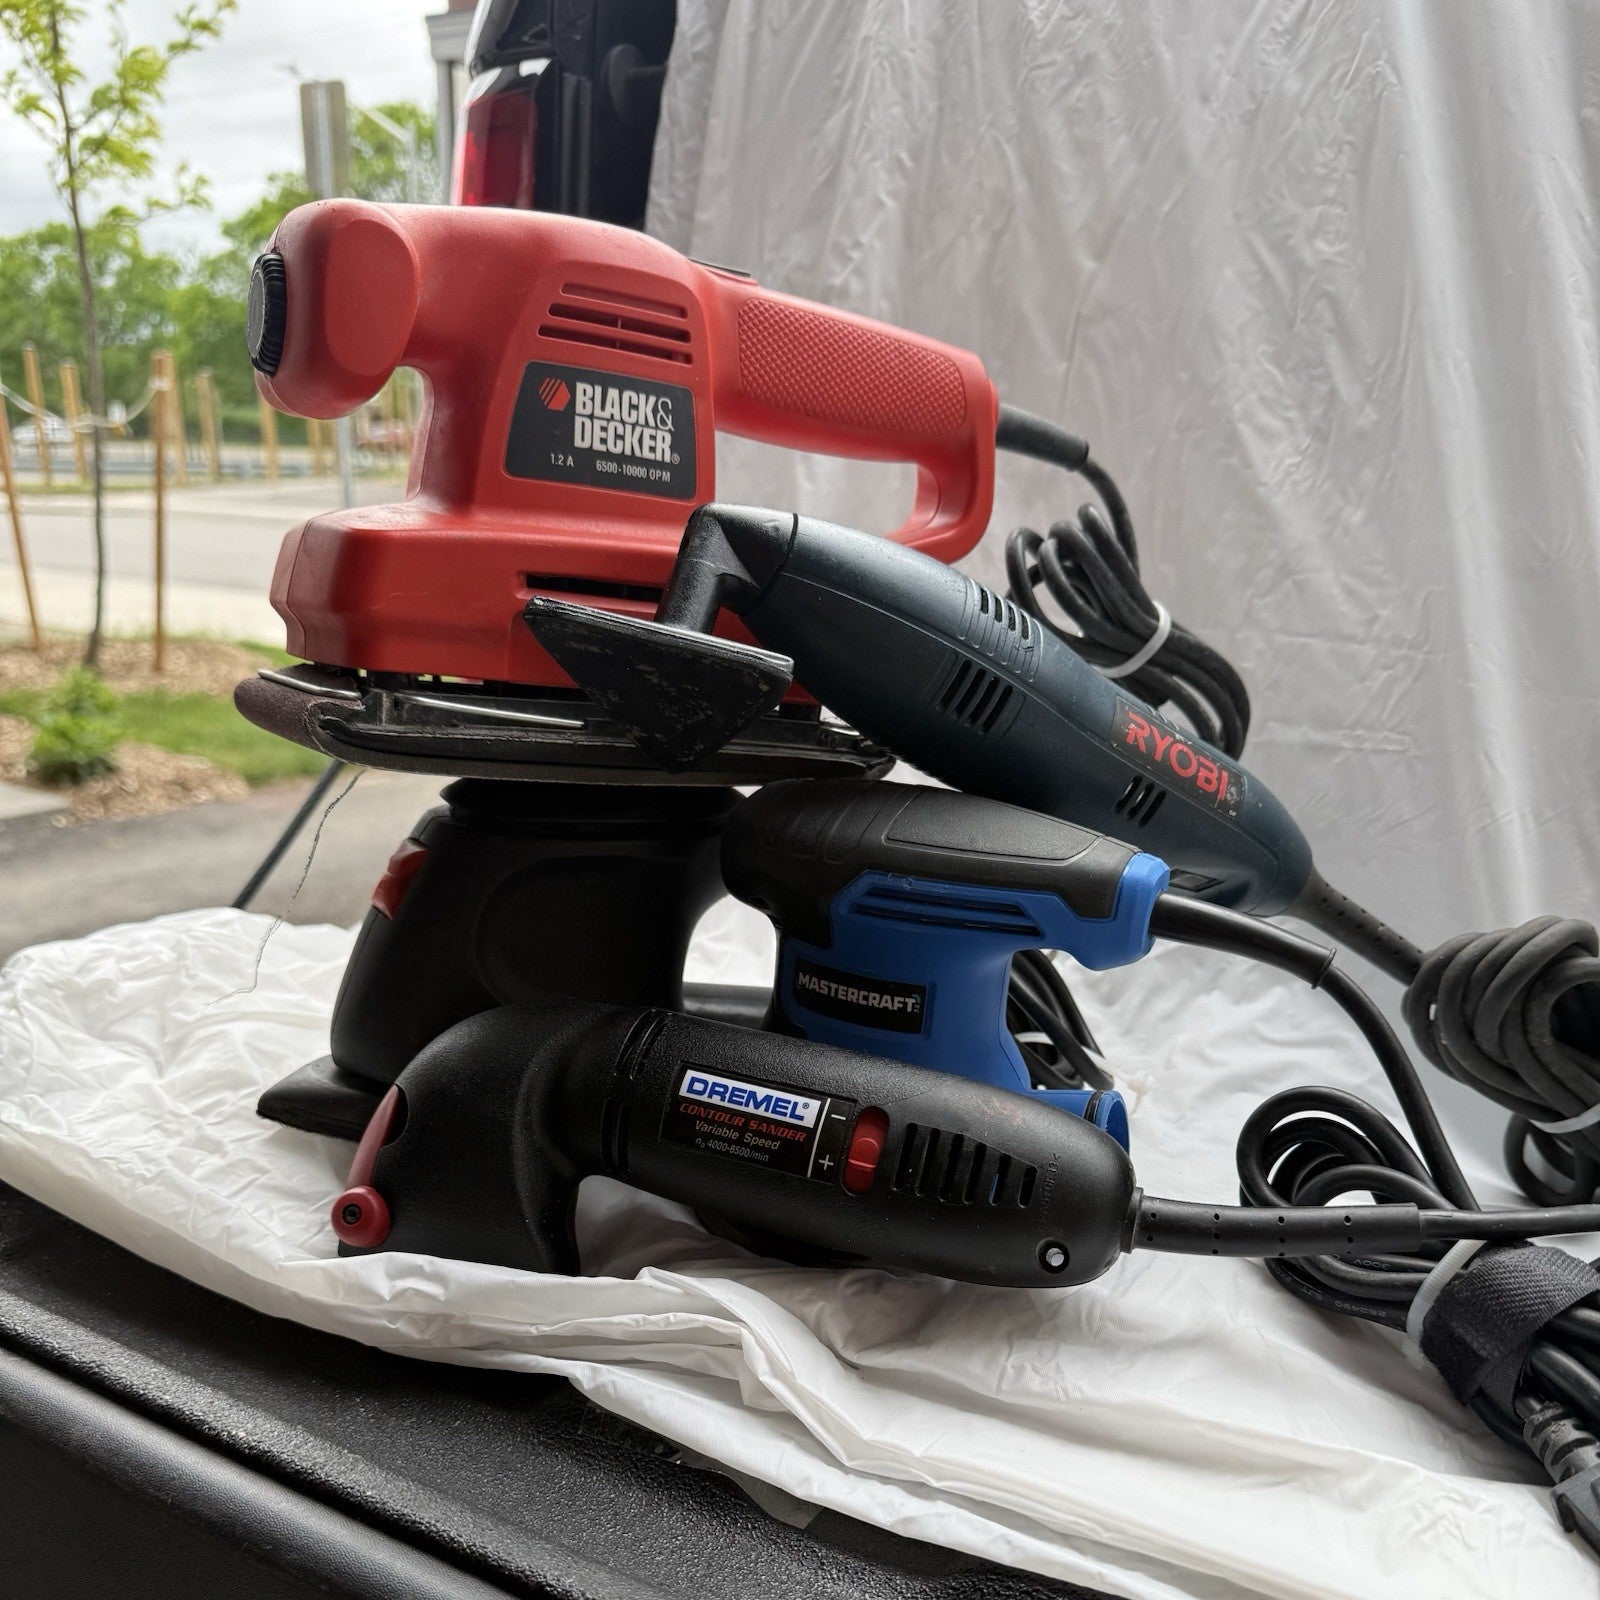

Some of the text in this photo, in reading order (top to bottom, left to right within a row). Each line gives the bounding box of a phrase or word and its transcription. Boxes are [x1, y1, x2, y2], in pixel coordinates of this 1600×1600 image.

[550, 453, 575, 467] 1.2 A
[595, 460, 671, 483] 6500-10000 OPM
[1125, 710, 1230, 801] RYOBI
[798, 971, 916, 1013] MASTERCRAFT
[679, 1102, 808, 1142] CONTOUR SANDER
[695, 1120, 781, 1150] Variable Speed
